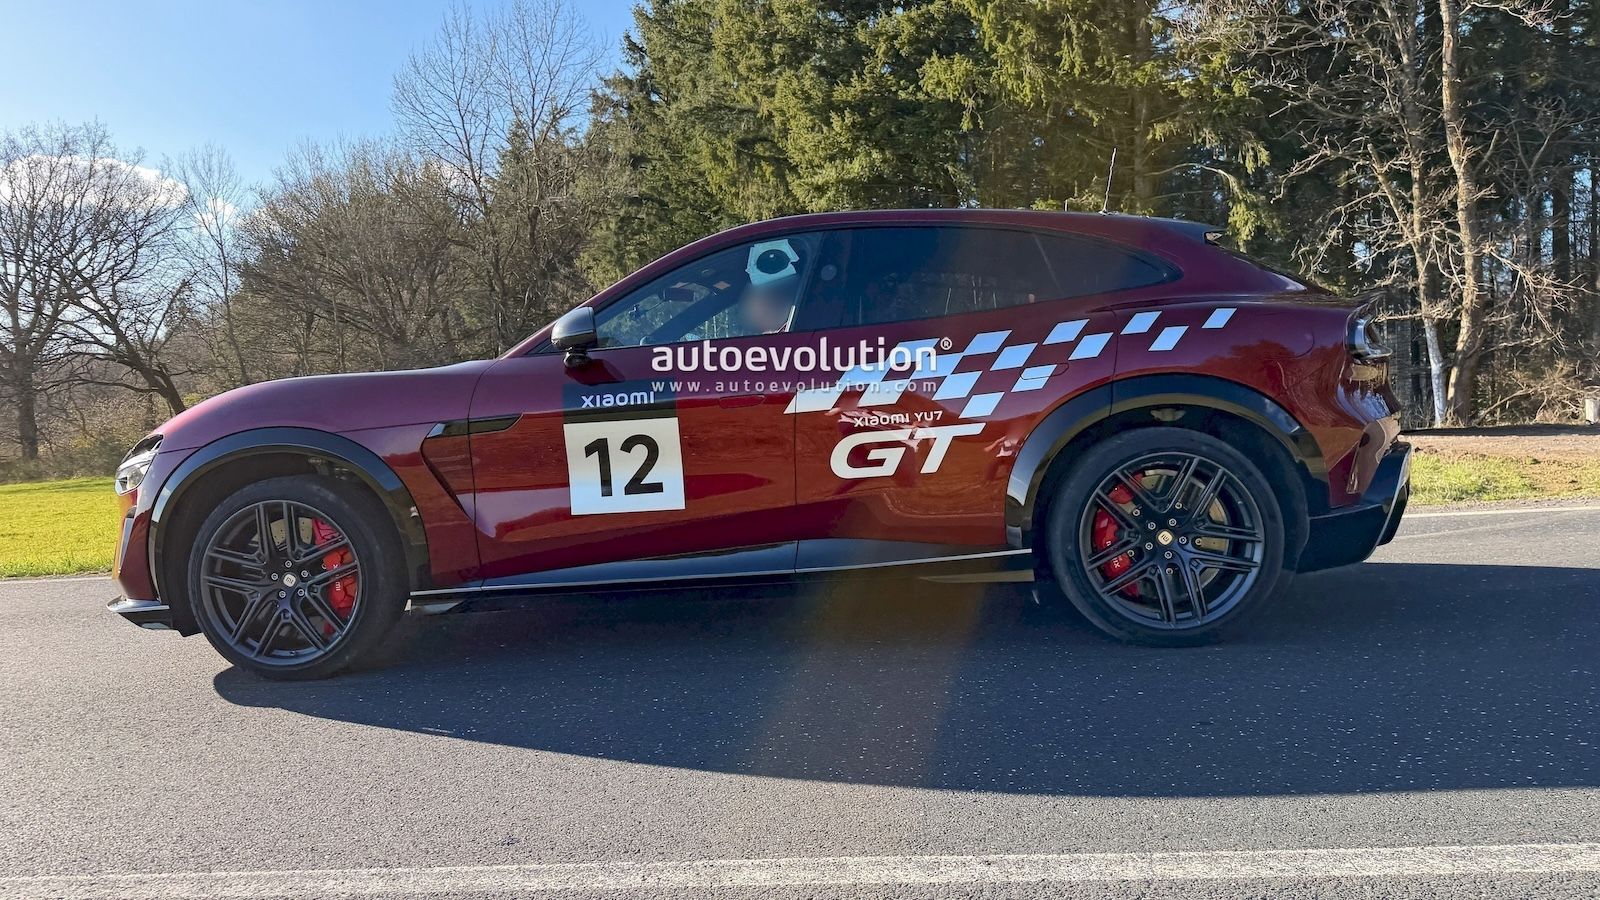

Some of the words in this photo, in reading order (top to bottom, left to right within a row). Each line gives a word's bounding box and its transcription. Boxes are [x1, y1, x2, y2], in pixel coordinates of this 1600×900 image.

[914, 410, 943, 422] YU7
[584, 433, 664, 498] 12
[829, 422, 987, 480] GT
